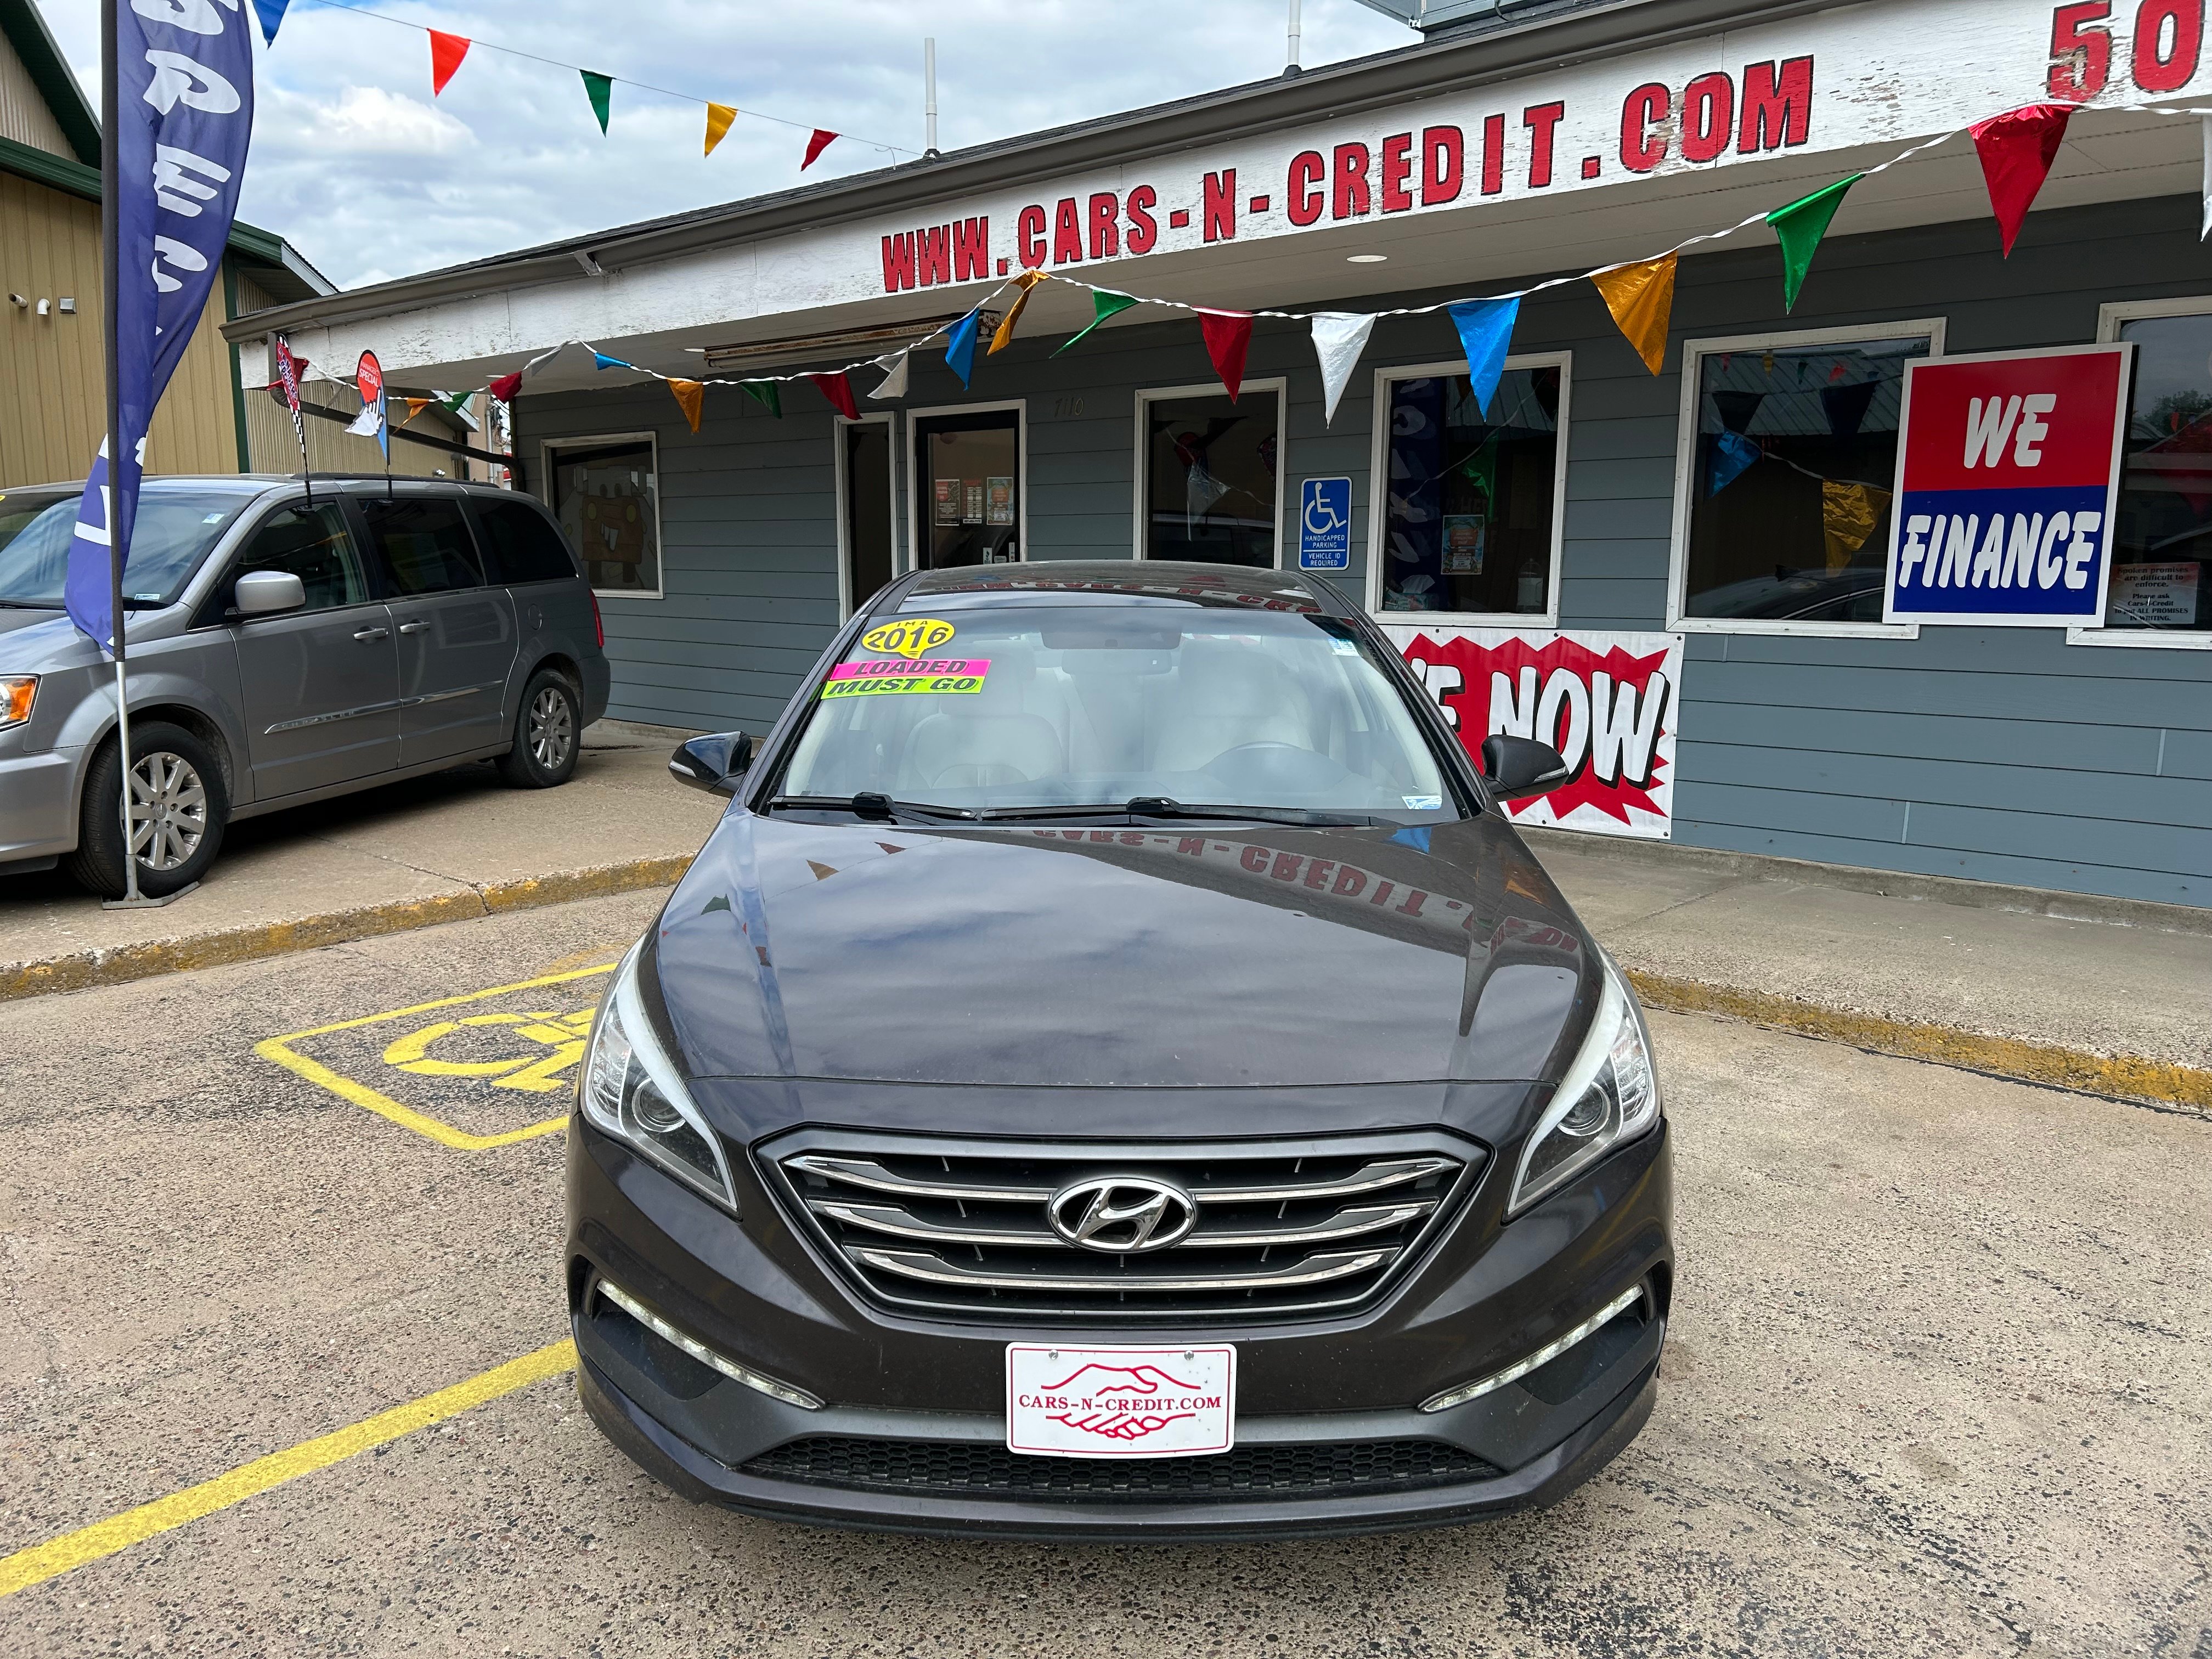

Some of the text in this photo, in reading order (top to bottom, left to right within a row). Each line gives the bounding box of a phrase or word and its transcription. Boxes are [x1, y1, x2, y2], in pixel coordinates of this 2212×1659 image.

[359, 368, 379, 387] SPECIAL
[1963, 393, 2057, 469] WE
[1898, 511, 2102, 590] FINANCE
[2150, 566, 2188, 575] promises
[867, 627, 949, 650] 2016
[854, 661, 970, 675] LOADED
[827, 678, 979, 696] MUST GO
[1488, 665, 1671, 789] NOW
[1019, 1395, 1221, 1411] CARS-N-CREDIT.COM
